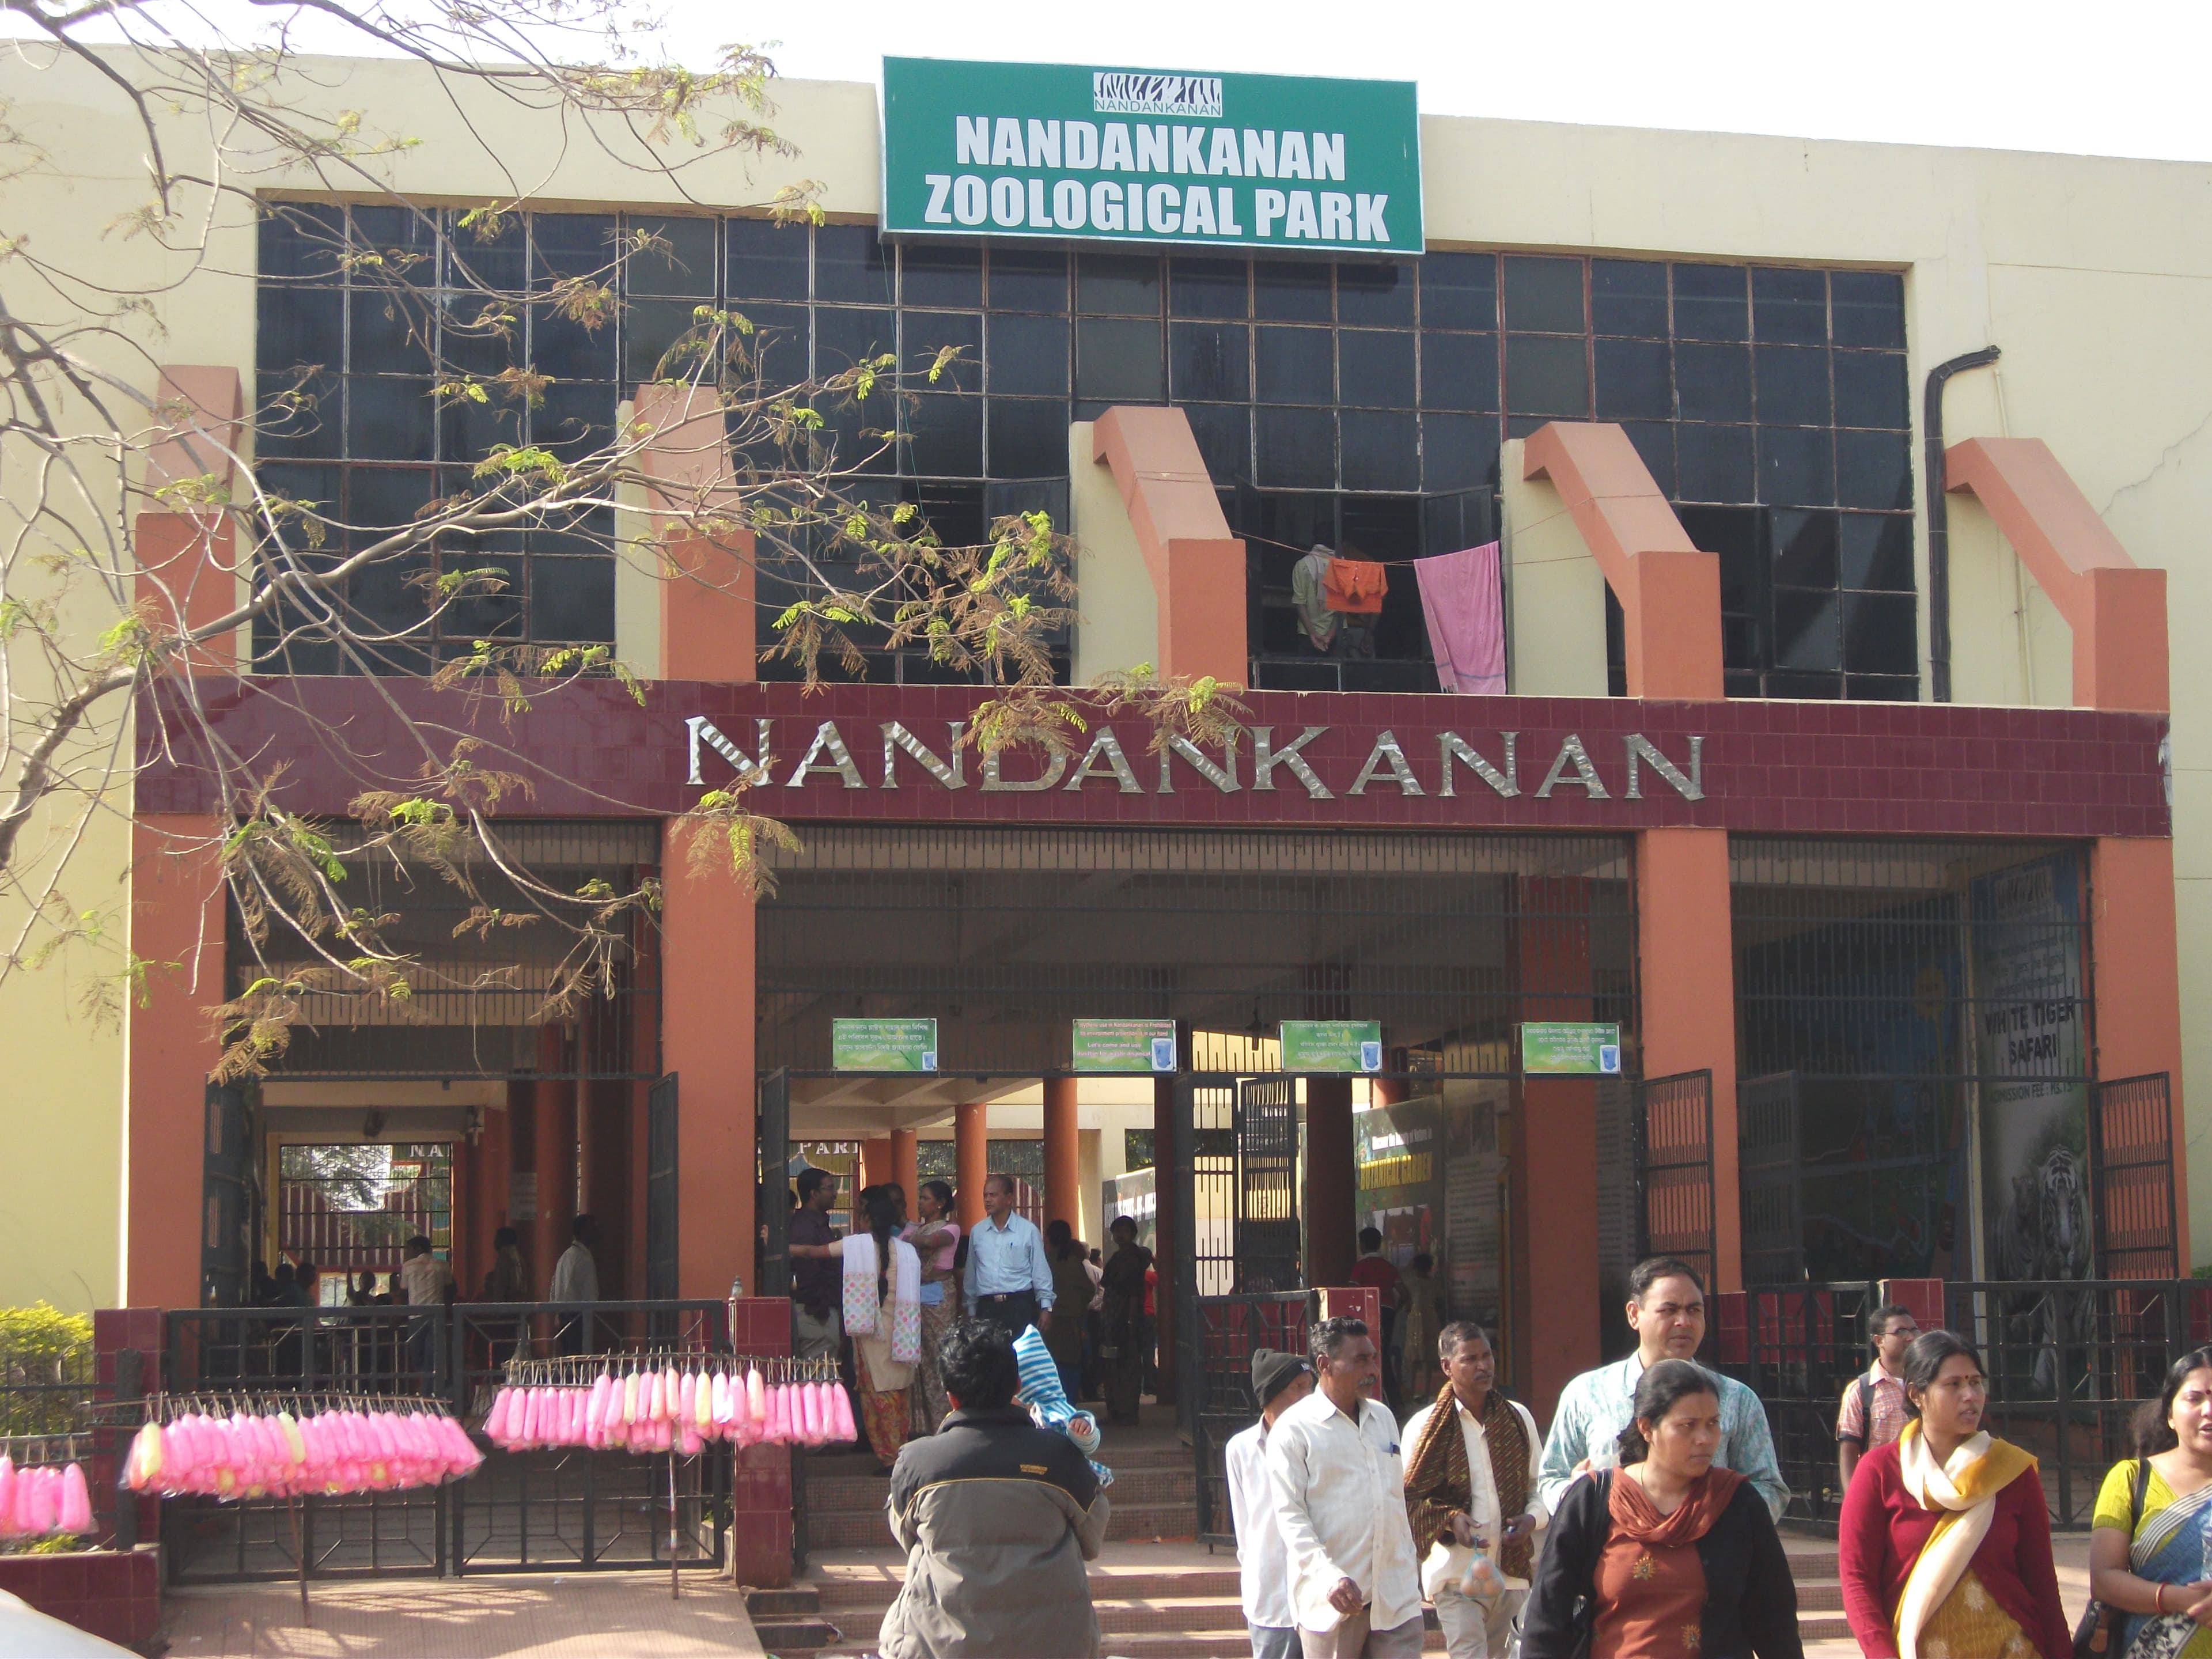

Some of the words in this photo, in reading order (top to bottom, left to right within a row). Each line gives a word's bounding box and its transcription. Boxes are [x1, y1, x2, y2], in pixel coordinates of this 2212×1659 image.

[1094, 99, 1221, 116] NANDANKANAN
[955, 115, 1346, 181] NANDANKANAN
[924, 174, 1242, 235] ZOOLOGICAL
[1255, 188, 1390, 242] PARK
[684, 715, 1706, 801] NANDANKANAN
[2009, 1033, 2057, 1065] SAFARI
